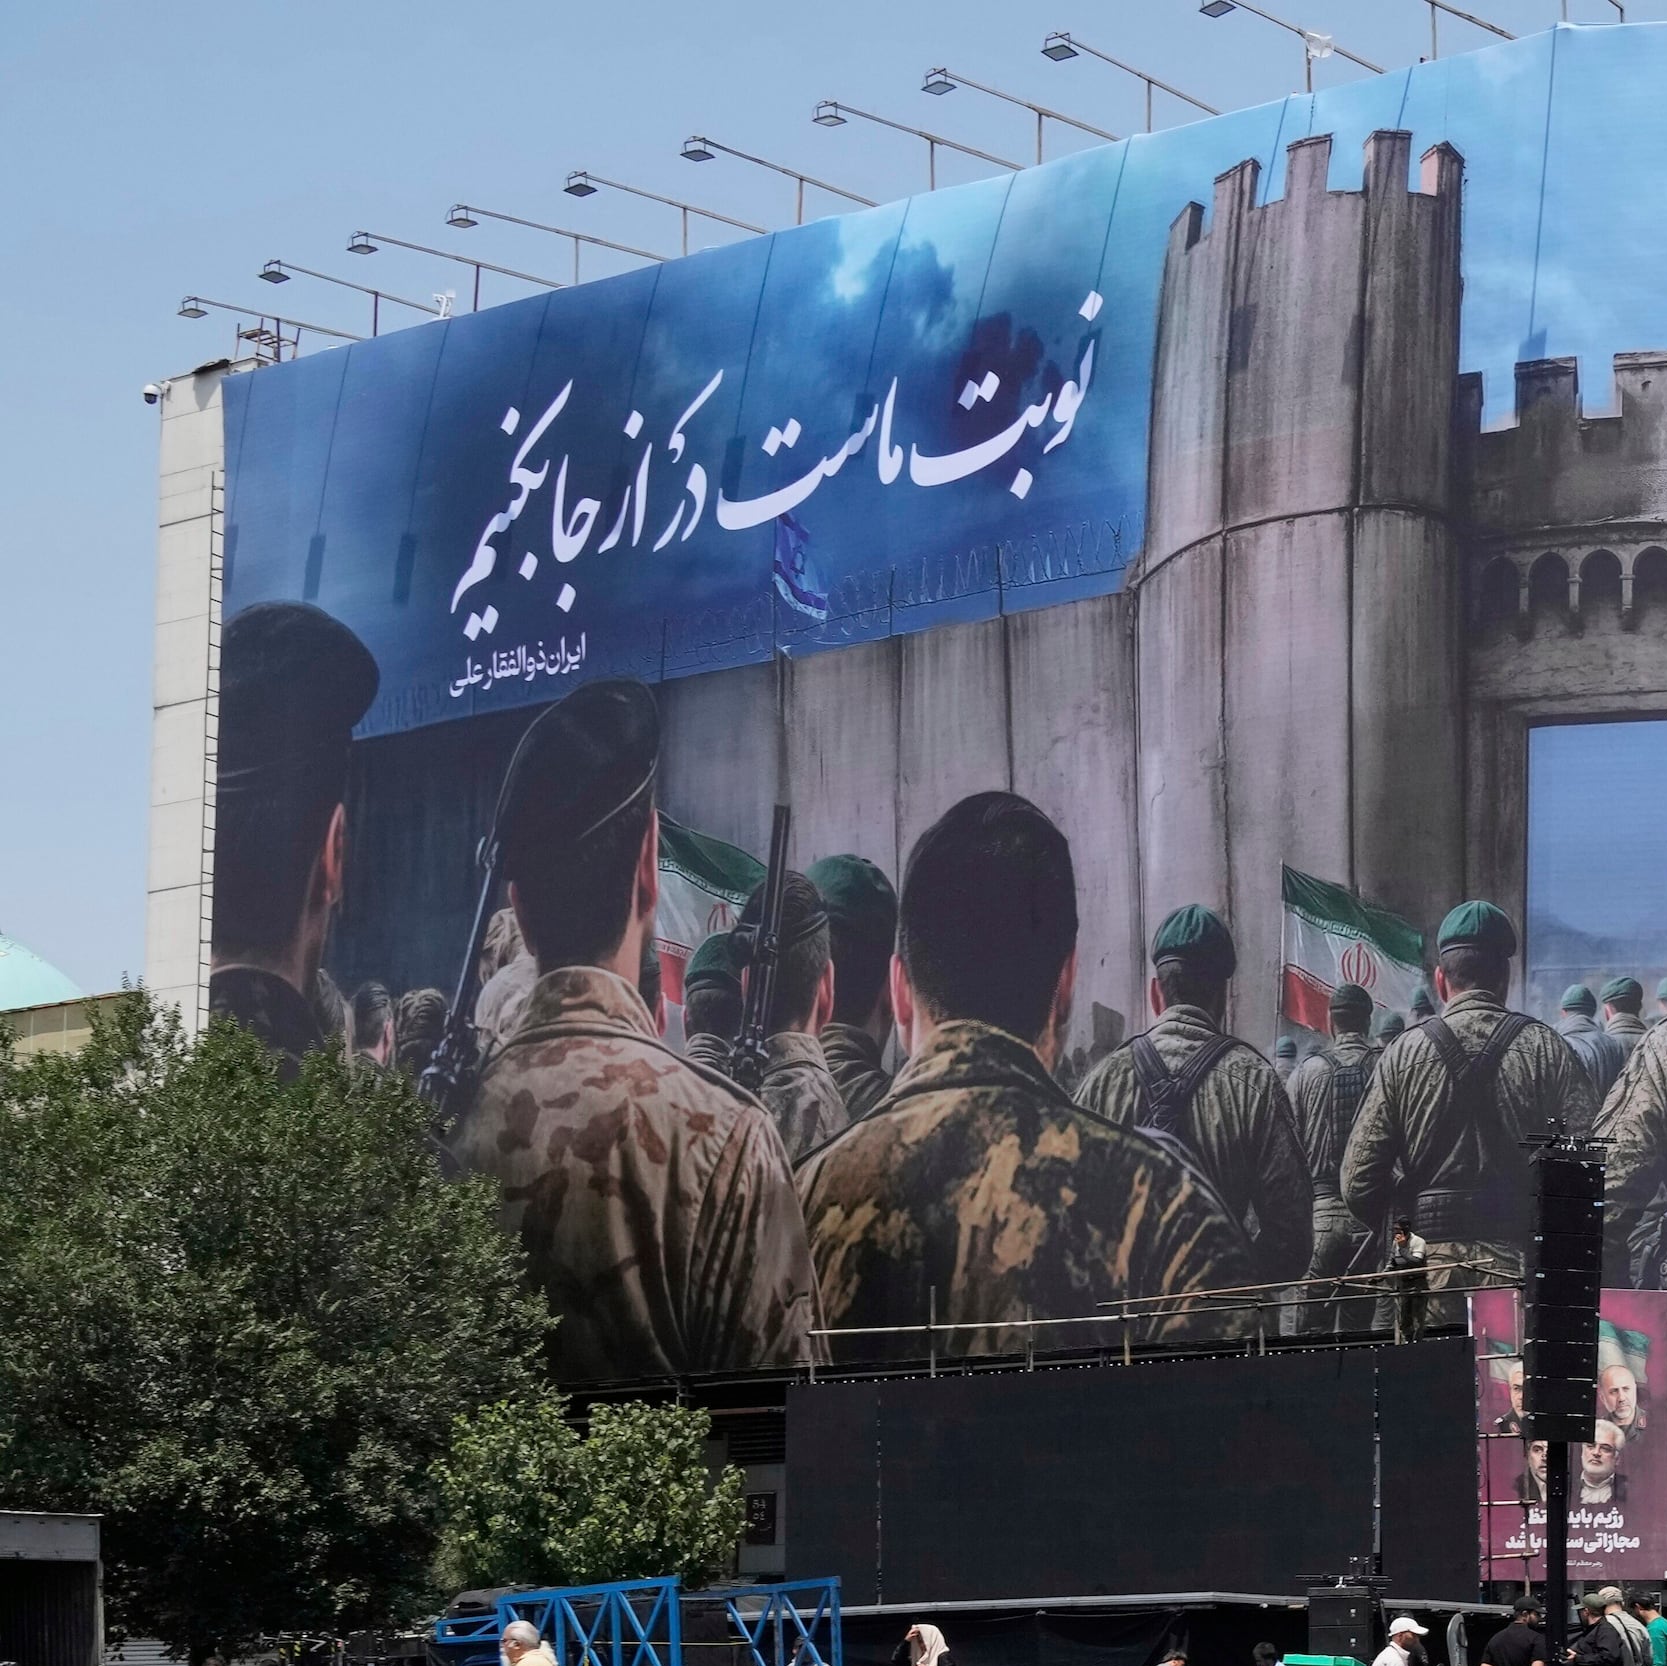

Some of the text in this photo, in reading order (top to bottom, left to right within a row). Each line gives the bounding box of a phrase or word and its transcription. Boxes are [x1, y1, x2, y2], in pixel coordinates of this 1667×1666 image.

[909, 290, 1103, 500] نوبت
[598, 410, 653, 554] از
[717, 375, 902, 531] ماست
[450, 632, 587, 697] ایران ذوالفقار علی
[1567, 1508, 1594, 1529] باید
[1583, 1532, 1640, 1553] مجازاتی
[1593, 1507, 1624, 1529] رژیم
